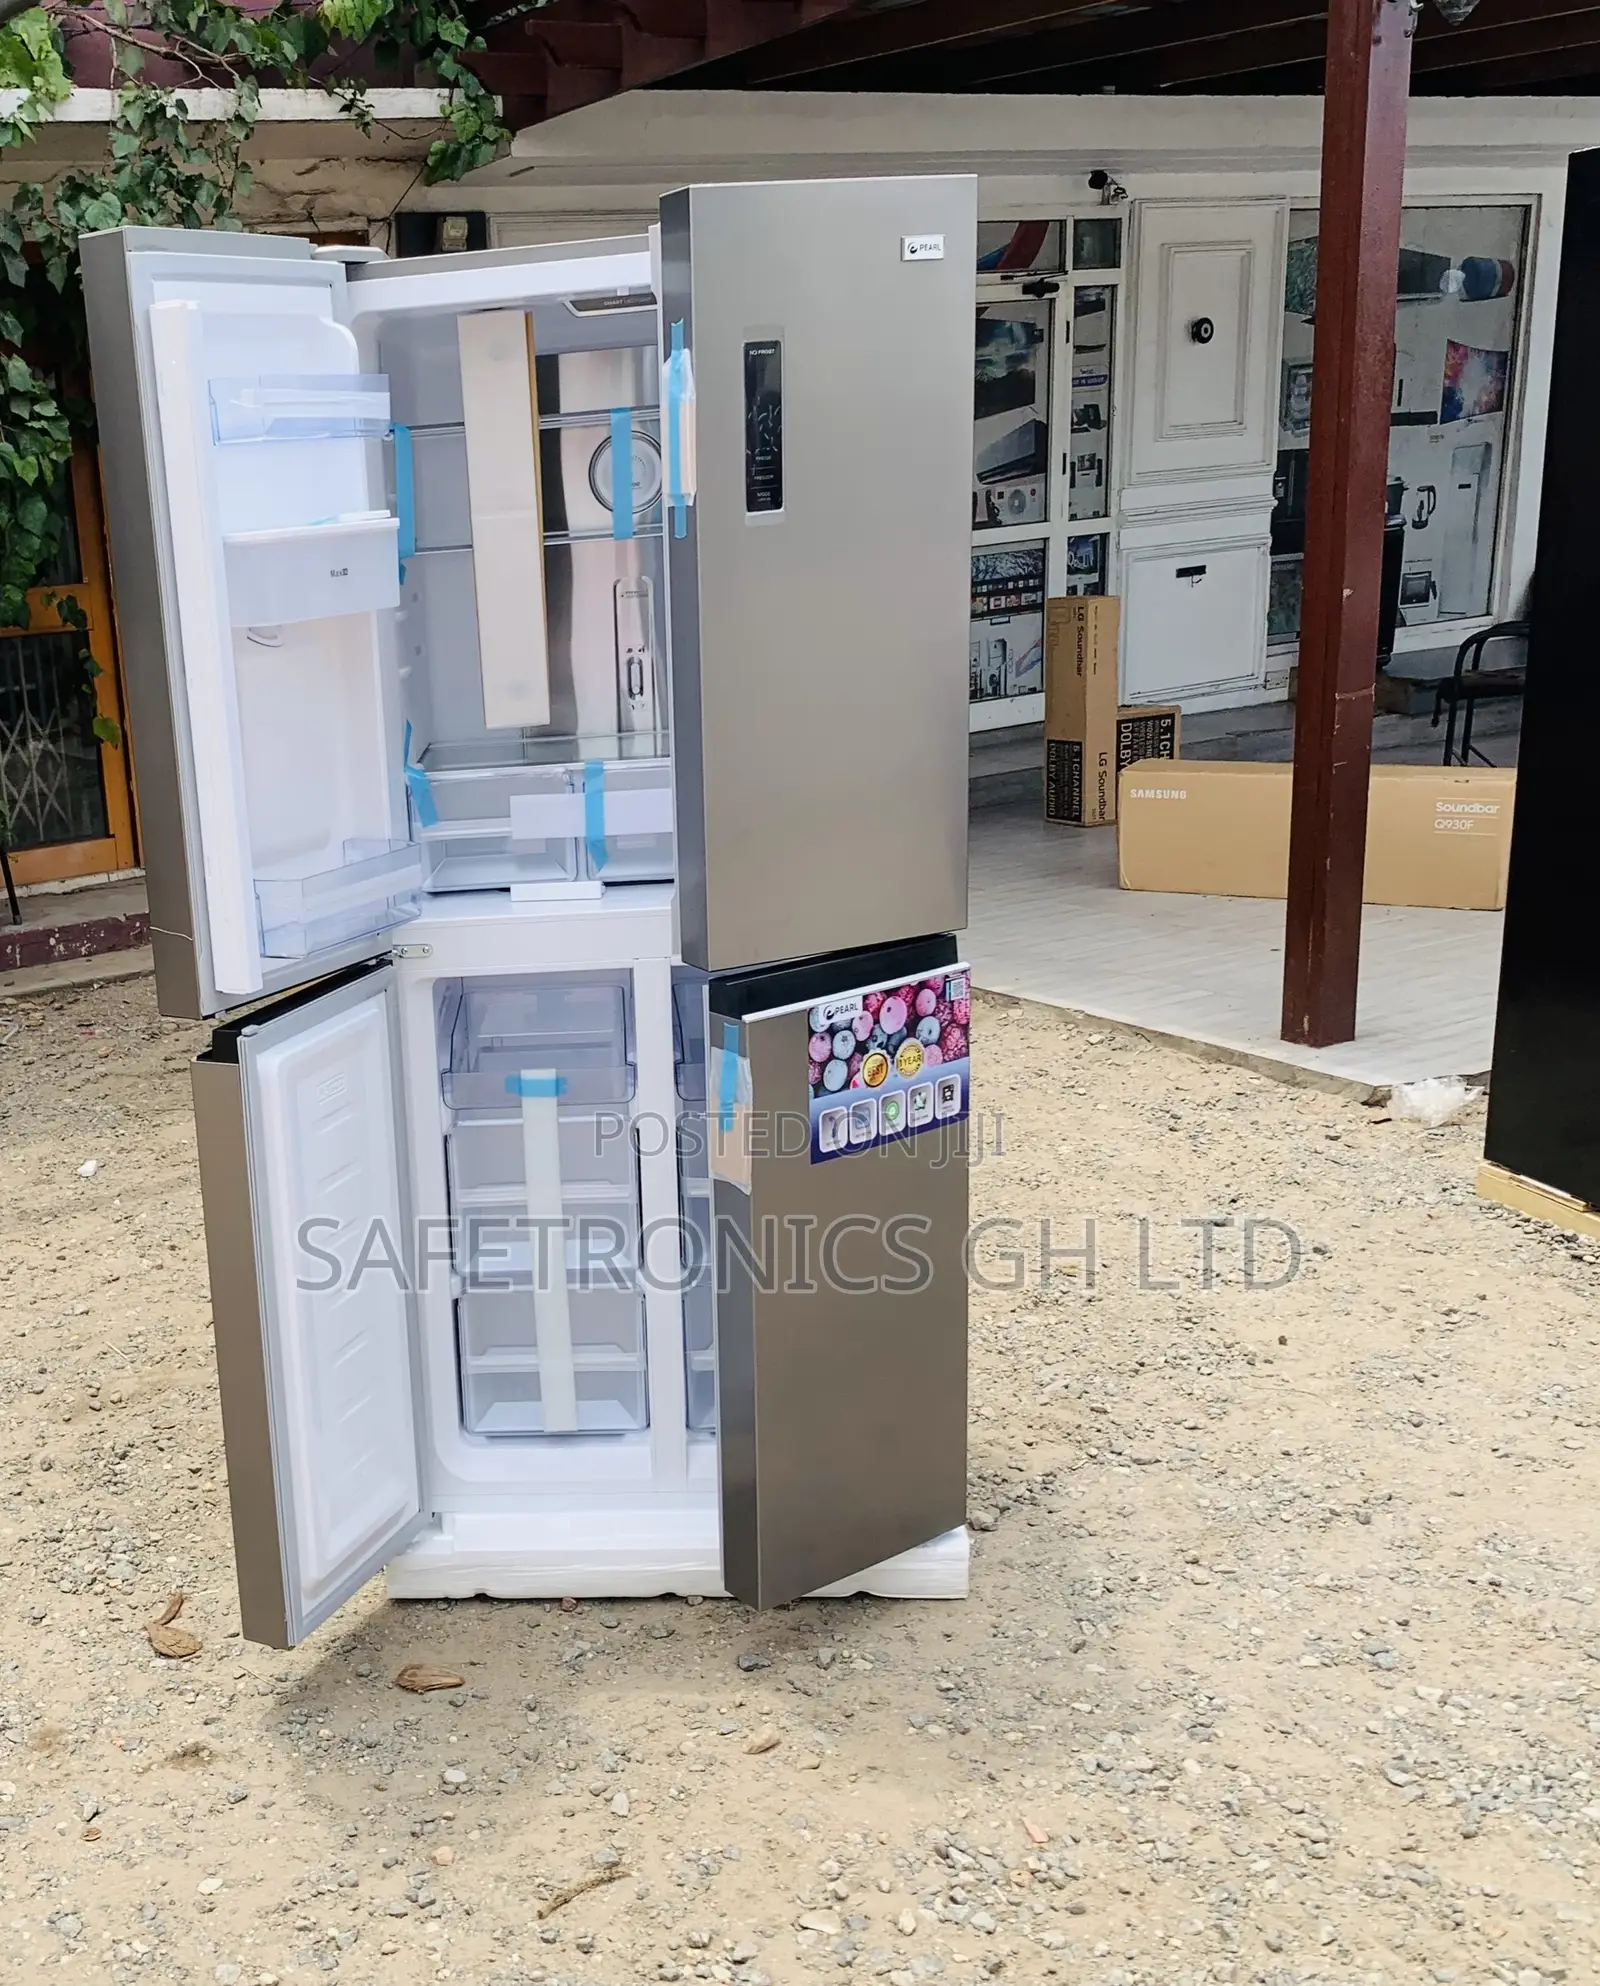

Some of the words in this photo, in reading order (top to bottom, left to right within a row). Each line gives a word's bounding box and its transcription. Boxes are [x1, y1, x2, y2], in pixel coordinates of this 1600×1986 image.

[919, 243, 942, 251] PEARL
[1077, 606, 1084, 621] LG
[1076, 625, 1084, 677] Soundbar
[1120, 723, 1132, 766] DOLBY
[1048, 743, 1056, 779] DOLBY
[1098, 752, 1107, 766] LG
[1048, 781, 1056, 815] AUDIO
[1098, 771, 1107, 820] Soundbar
[1130, 788, 1187, 800] SAMSUNG
[1435, 802, 1501, 814] Soundbar
[1434, 819, 1474, 830] Q930F
[835, 1002, 858, 1014] PEARL
